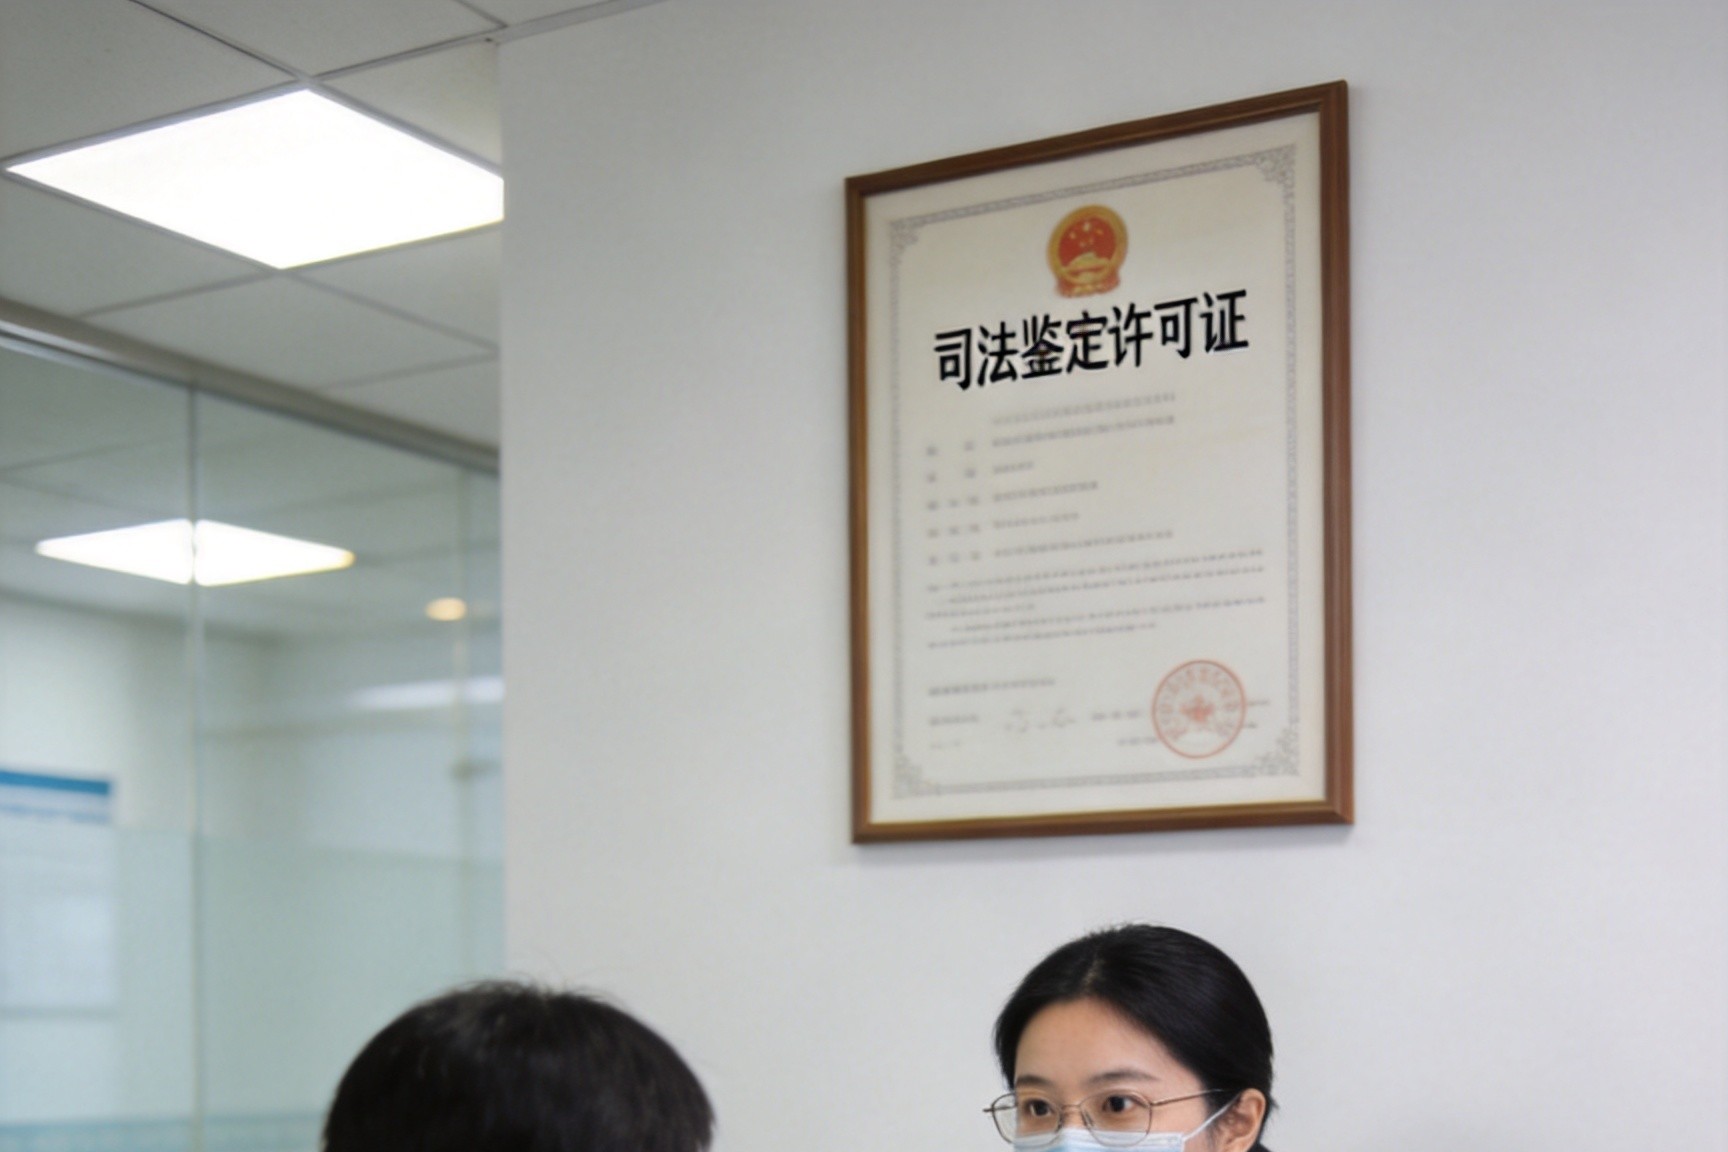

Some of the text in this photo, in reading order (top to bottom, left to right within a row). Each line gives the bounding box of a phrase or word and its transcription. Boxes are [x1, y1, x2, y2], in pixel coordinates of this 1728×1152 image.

[934, 290, 1249, 391] 司法鉴定许可证
